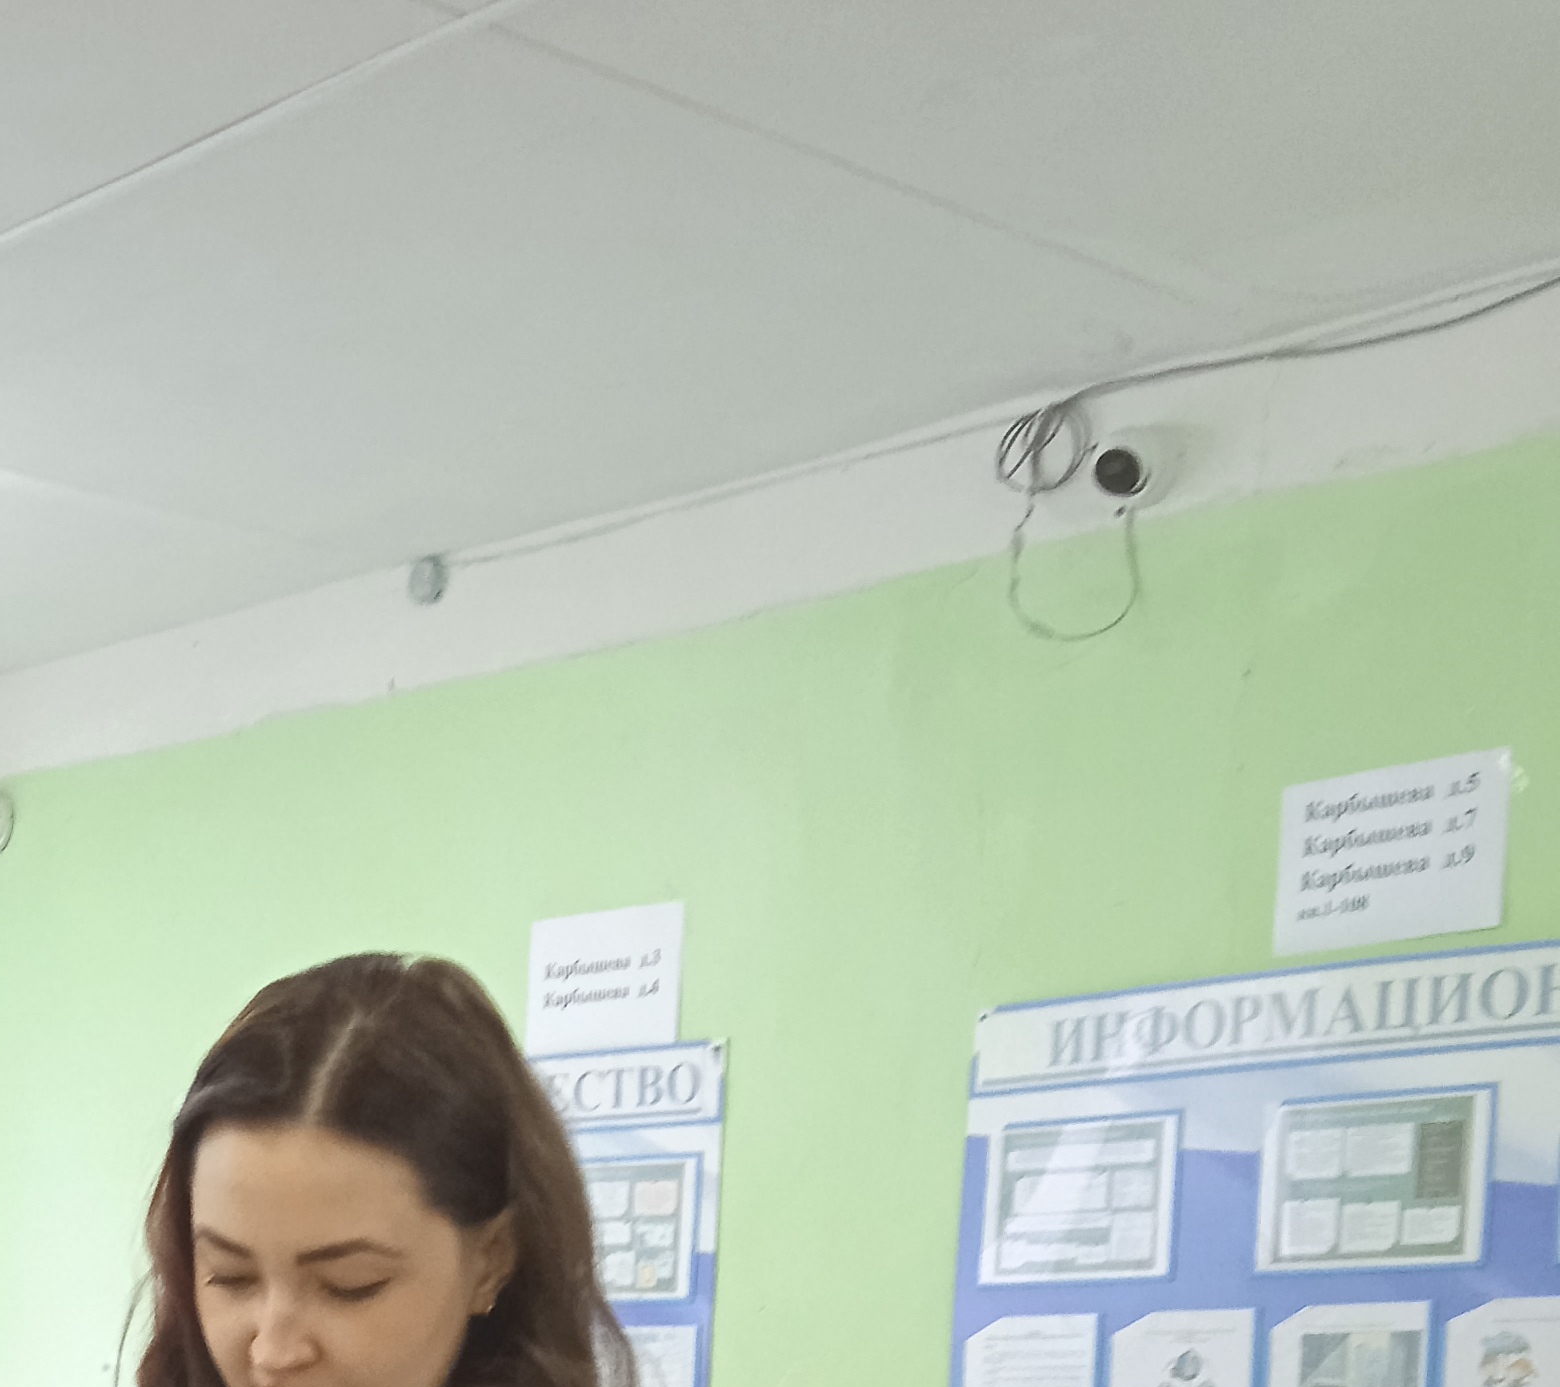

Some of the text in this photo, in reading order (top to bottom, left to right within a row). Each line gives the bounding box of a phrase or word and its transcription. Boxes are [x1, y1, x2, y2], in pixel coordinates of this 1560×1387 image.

[1304, 784, 1436, 823] Карбышева
[1301, 819, 1434, 858] Карбышева
[1299, 855, 1431, 892] Карбышева
[543, 956, 632, 982] Карбышева
[542, 986, 630, 1011] Карбышева
